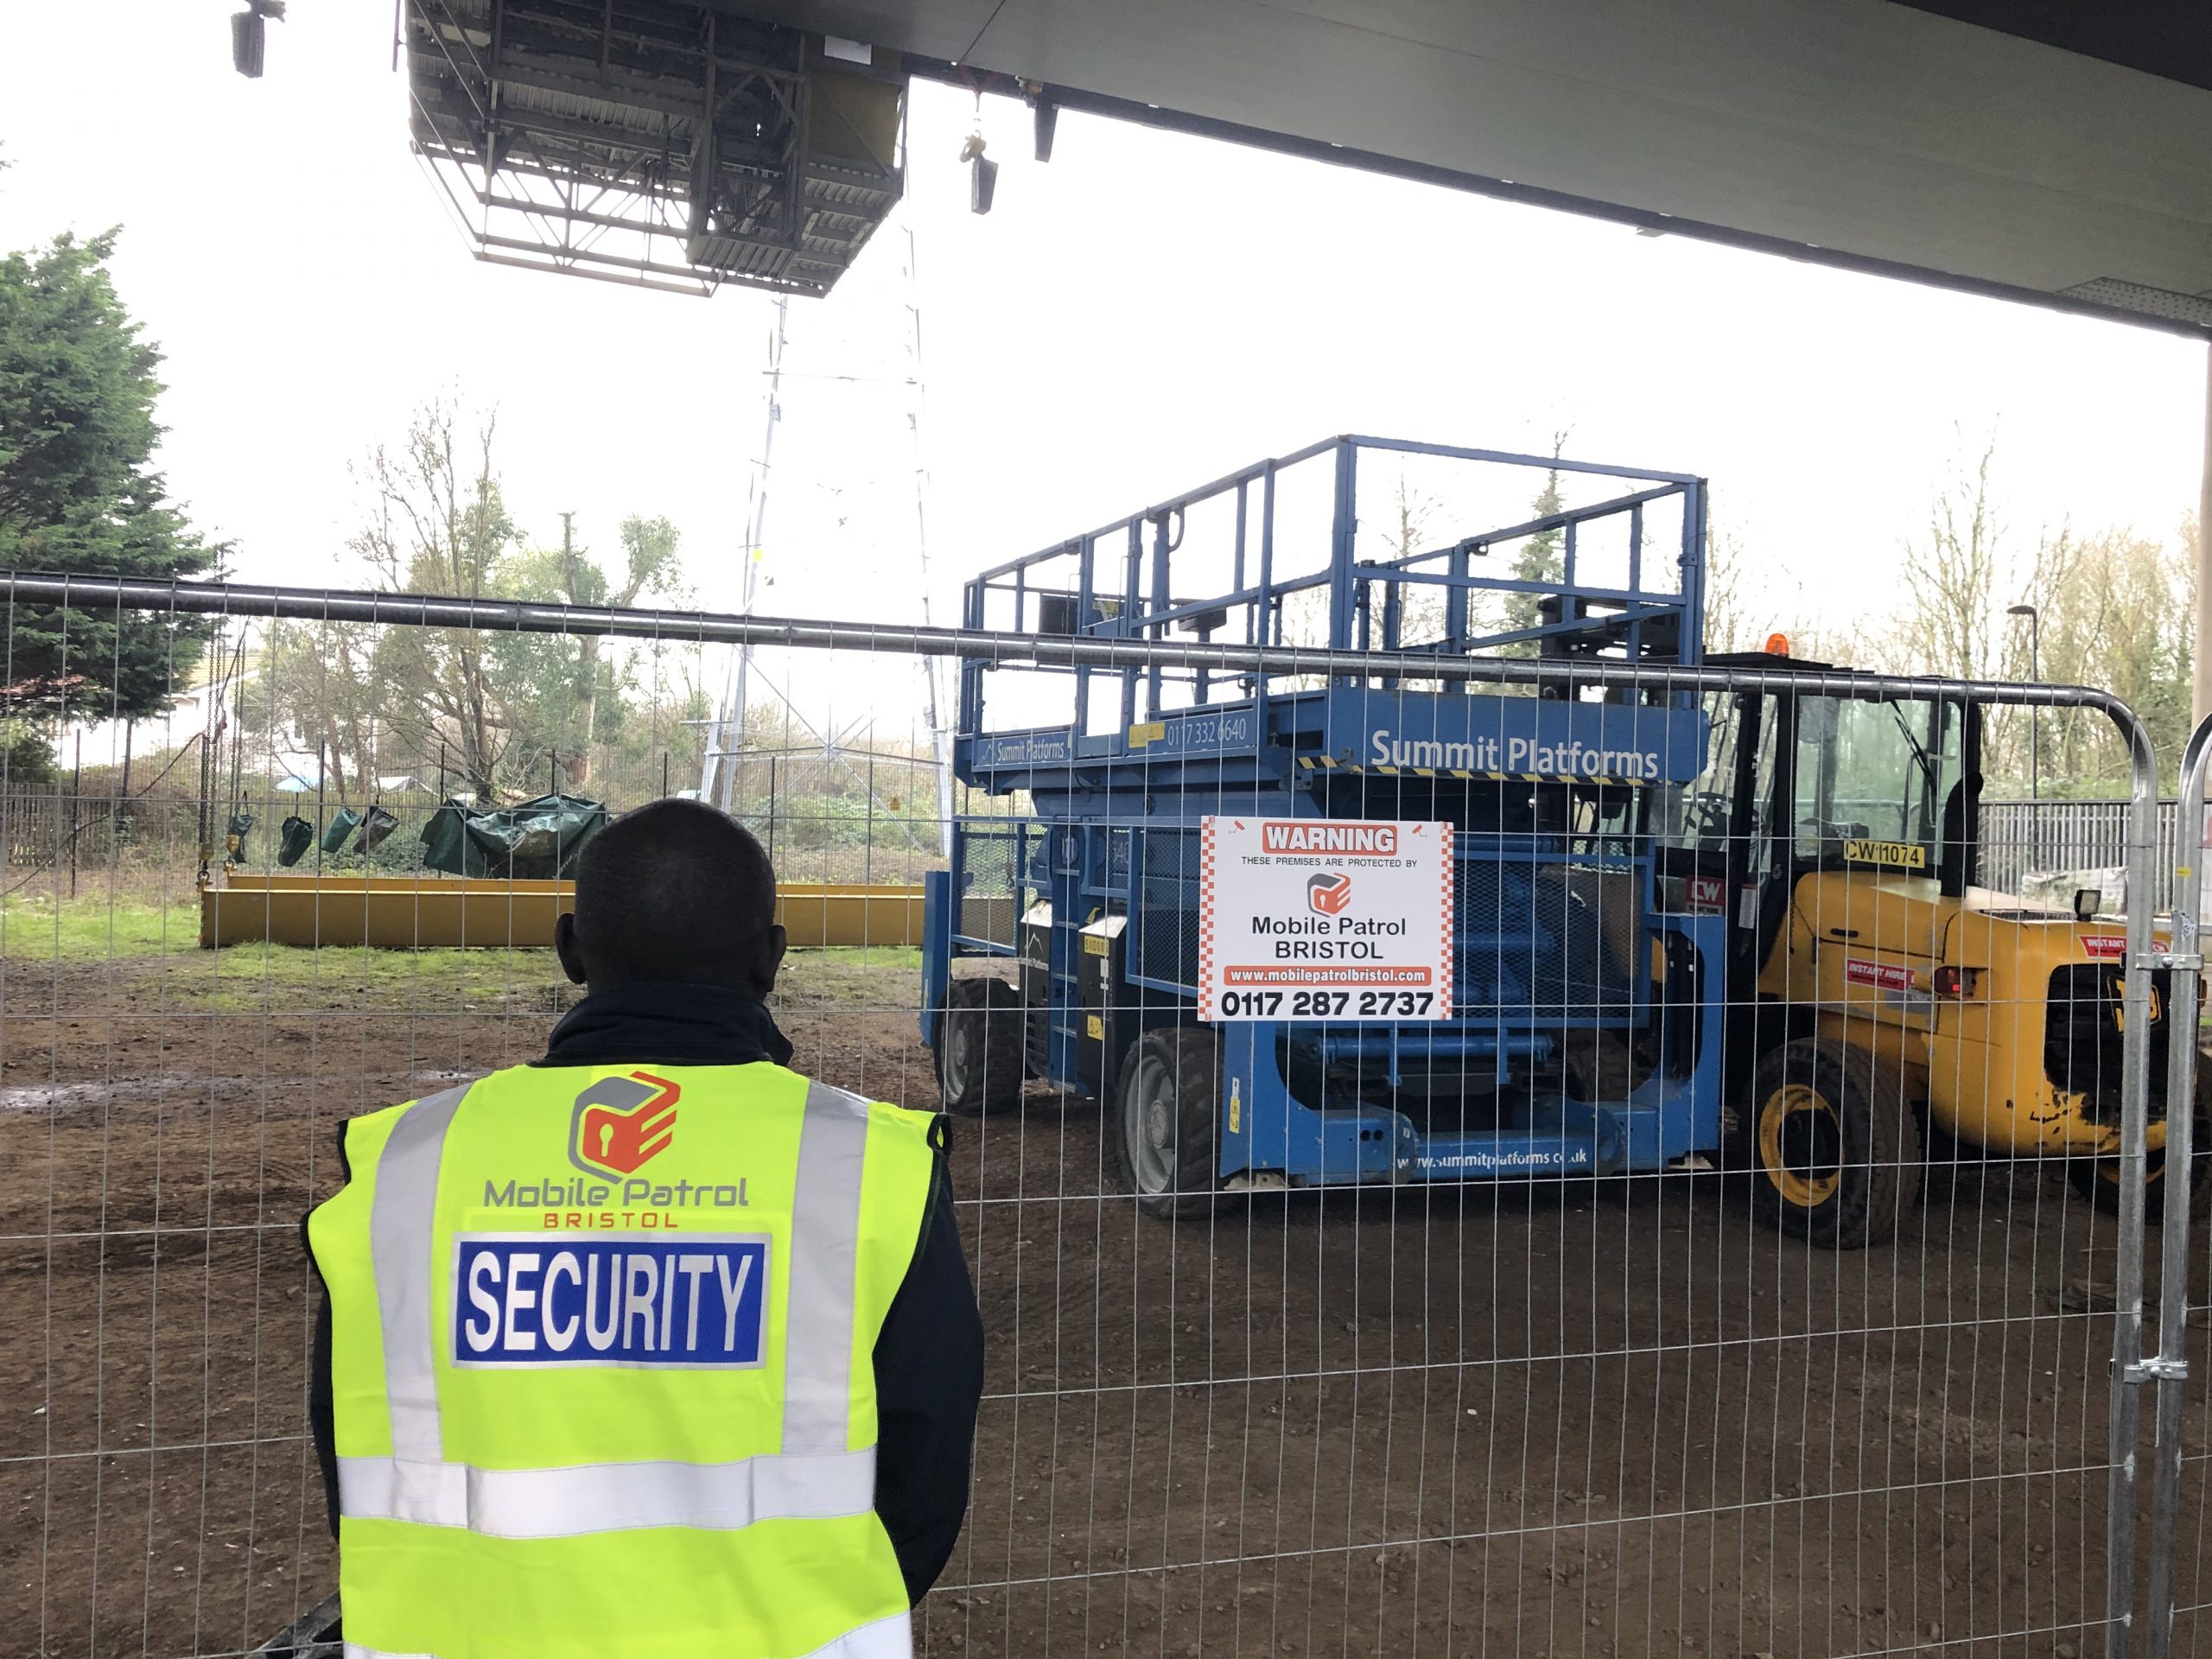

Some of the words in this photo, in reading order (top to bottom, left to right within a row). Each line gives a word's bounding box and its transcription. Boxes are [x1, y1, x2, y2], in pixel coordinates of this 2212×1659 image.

[1167, 724, 1193, 747] 0117
[1195, 721, 1215, 744] 332
[1217, 717, 1247, 741] 6640
[997, 741, 1026, 761] Summit
[1026, 738, 1065, 760] Platforms
[1371, 729, 1498, 772] Summit
[1508, 736, 1658, 779] Platforms
[1265, 825, 1395, 853] WARNING
[1241, 856, 1271, 865] THESE
[1276, 857, 1321, 866] PREMISES
[1348, 859, 1402, 868] PROTECTED
[1252, 916, 1331, 935] Mobile
[1339, 918, 1406, 936] Patrol
[1274, 941, 1384, 960] BRISTOL
[2087, 938, 2126, 949] INSTANT
[1230, 969, 1426, 984] www.mobilepatrolbristol.com
[1848, 963, 1885, 976] INSTANT
[1221, 992, 1283, 1017] 0117
[1292, 992, 1350, 1016] 287
[1358, 992, 1433, 1016] 2737
[484, 1179, 609, 1207] Mobile
[622, 1178, 749, 1207] Patrol
[543, 1212, 678, 1228] BRISTOL
[465, 1250, 753, 1352] SECURITY
